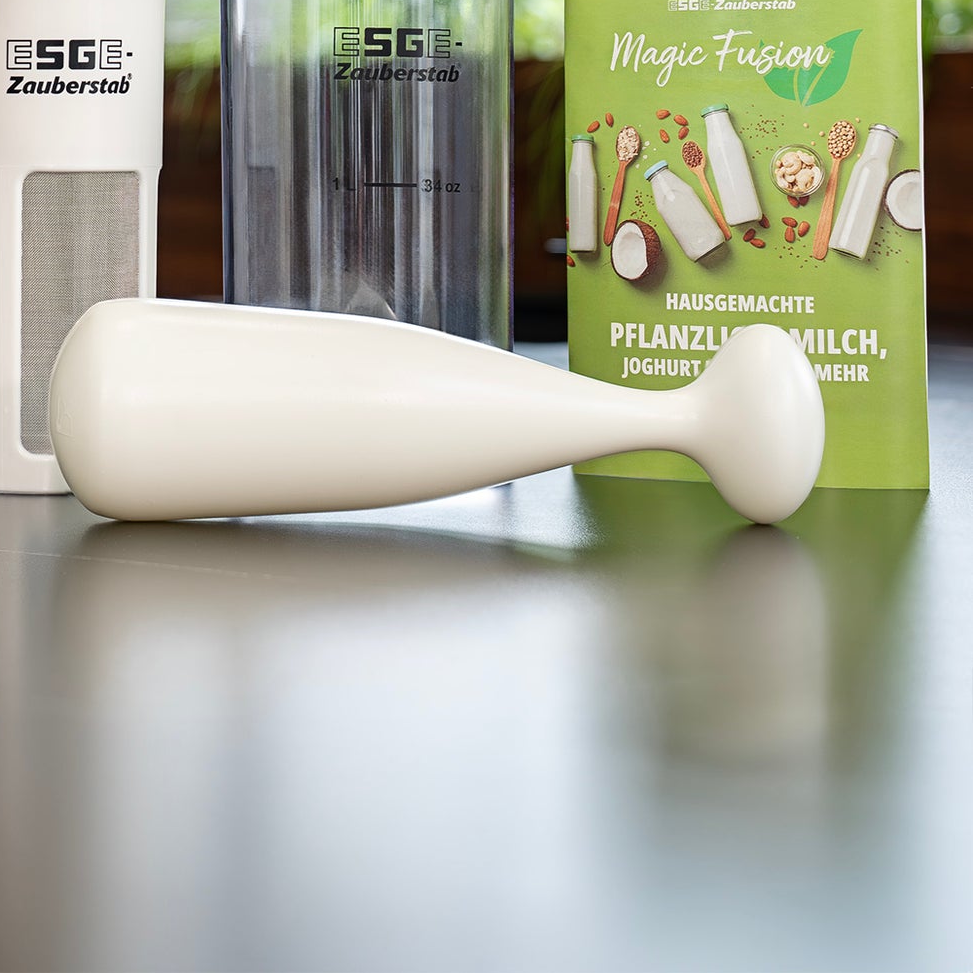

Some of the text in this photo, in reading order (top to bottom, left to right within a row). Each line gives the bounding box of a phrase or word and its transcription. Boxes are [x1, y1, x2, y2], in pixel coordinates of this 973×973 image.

[609, 28, 831, 87] Magic Fusion
[422, 178, 461, 193] 34 oz
[666, 292, 815, 314] HAUSGEMACHTE
[789, 327, 888, 360] MILCH,
[621, 356, 702, 379] JOGHURT
[814, 363, 870, 382] MEHR
